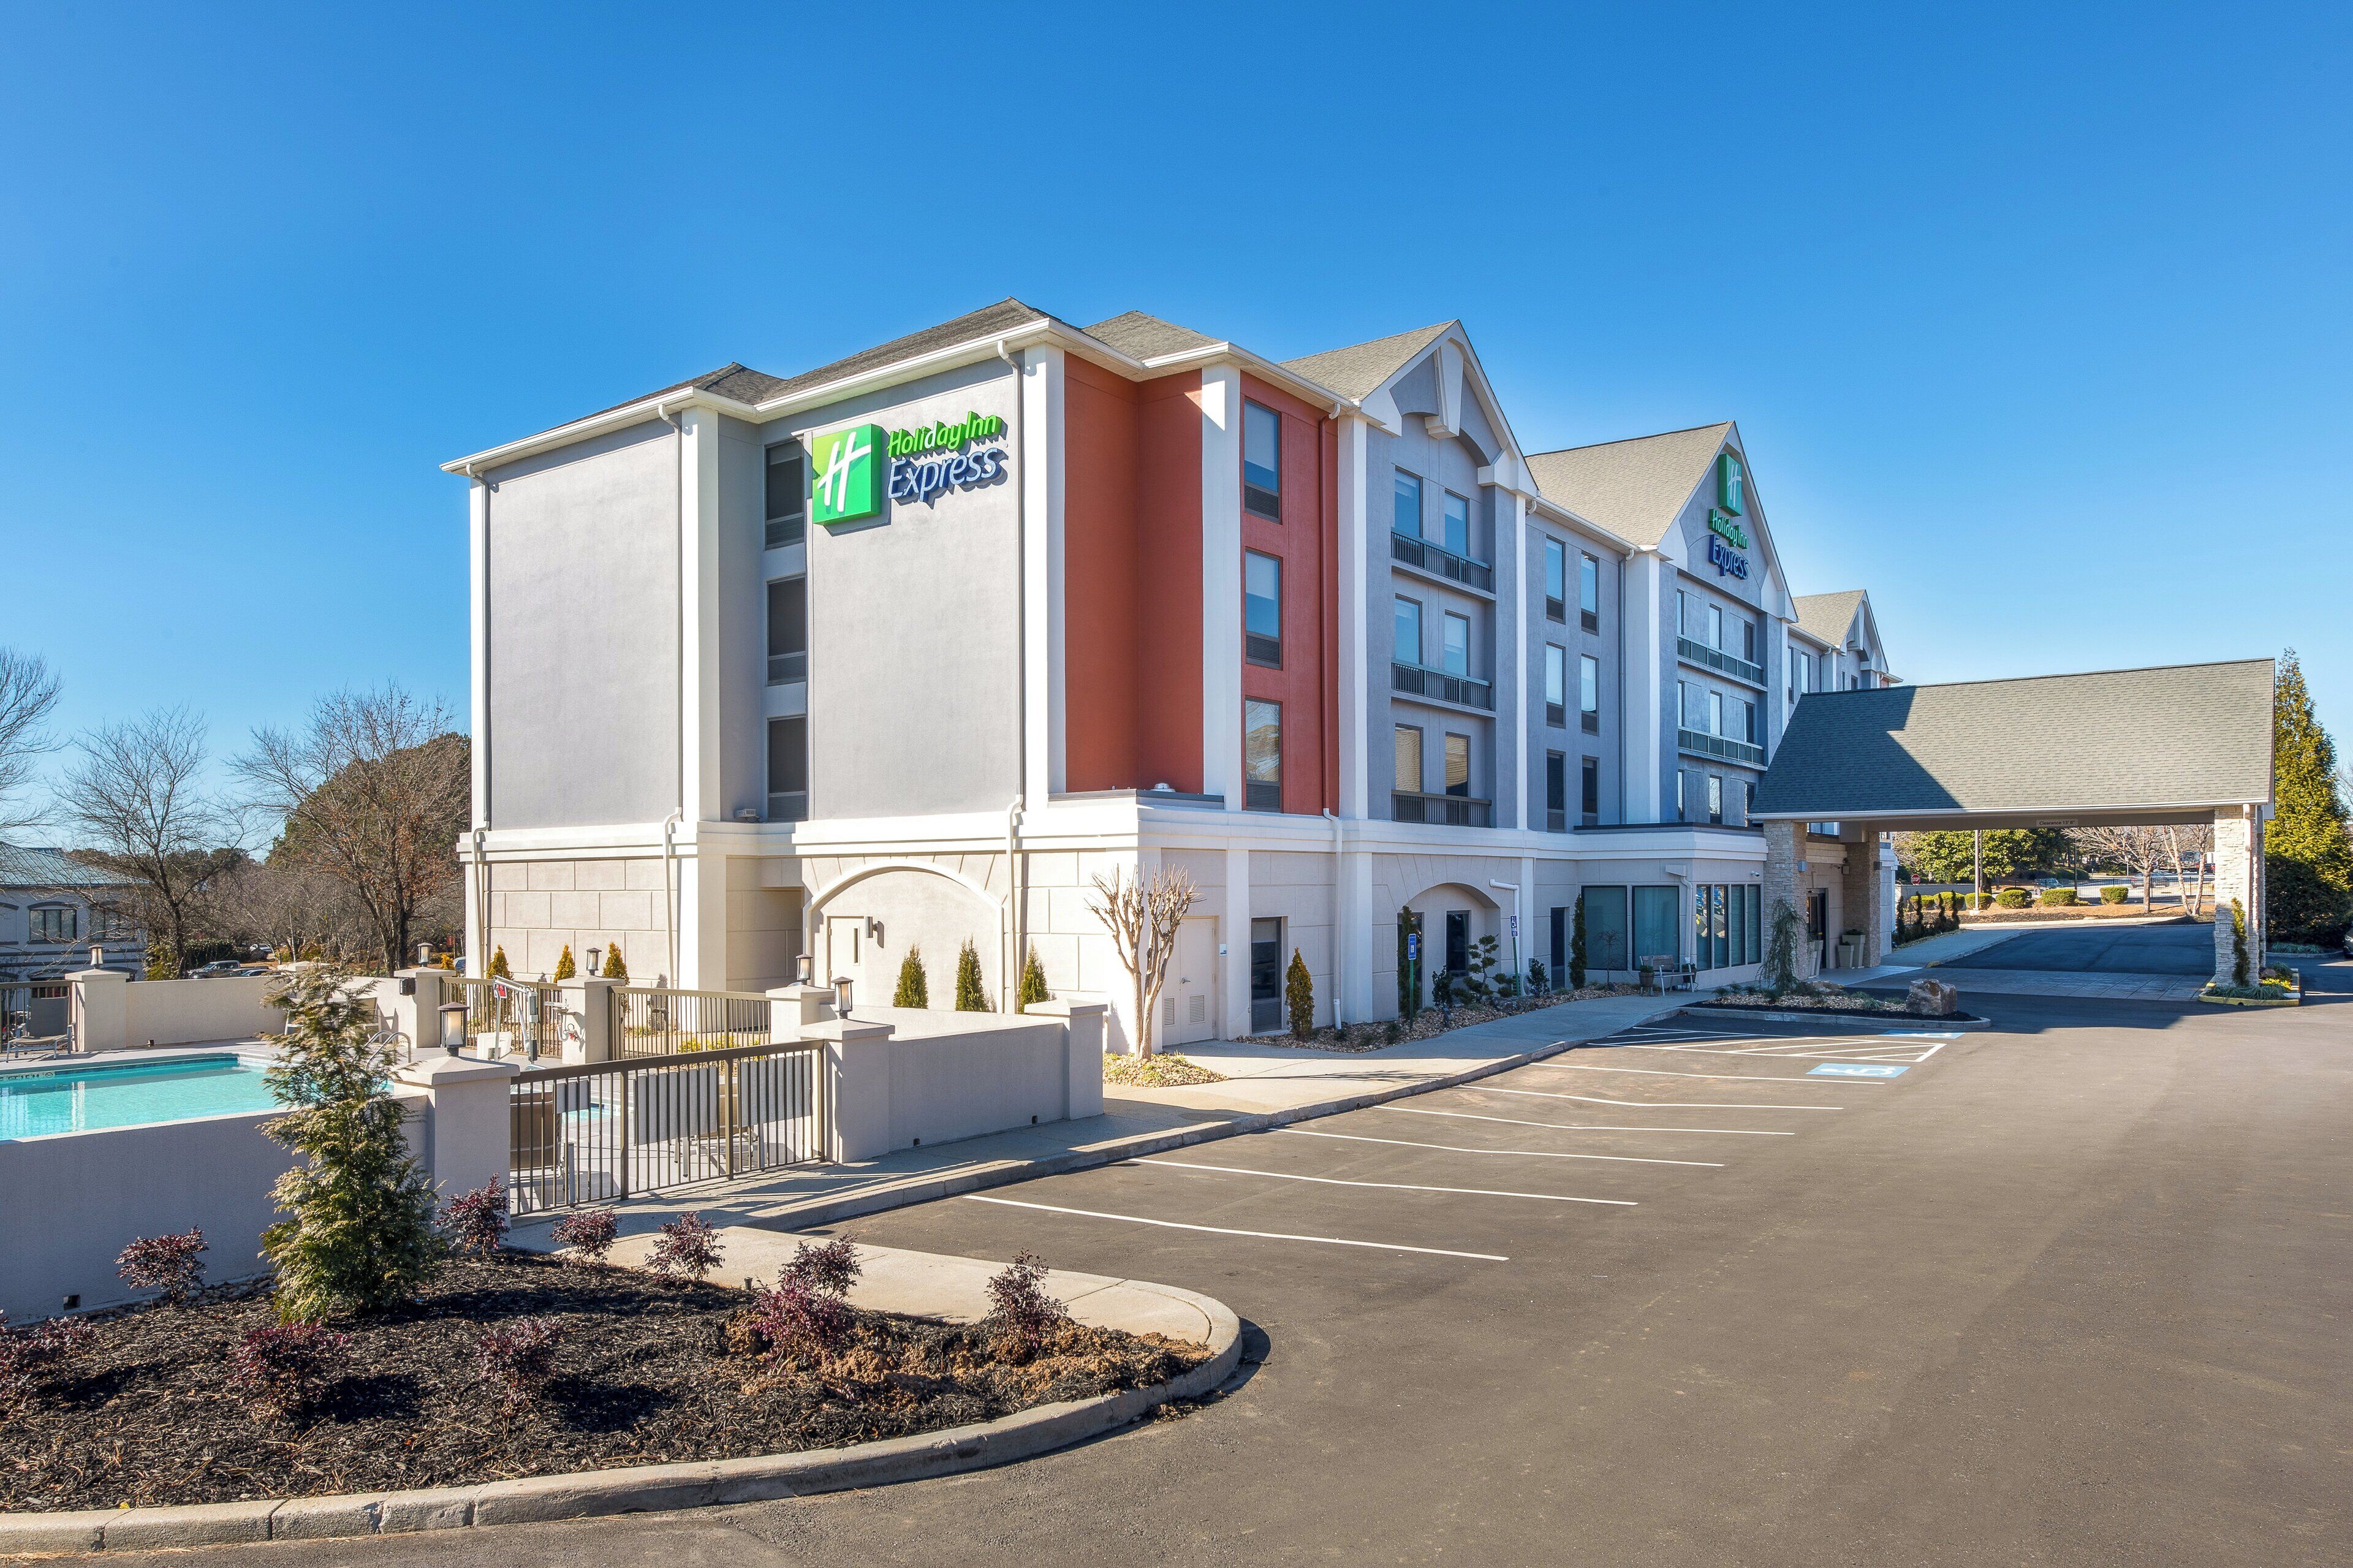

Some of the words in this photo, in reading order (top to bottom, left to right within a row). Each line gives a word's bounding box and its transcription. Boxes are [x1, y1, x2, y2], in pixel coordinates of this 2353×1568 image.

[887, 420, 964, 457] Holiday
[964, 411, 1001, 439] Inn
[888, 447, 1003, 502] Express
[1710, 509, 1738, 547] Holiday
[1737, 525, 1748, 549] Inn
[1710, 534, 1748, 580] Express
